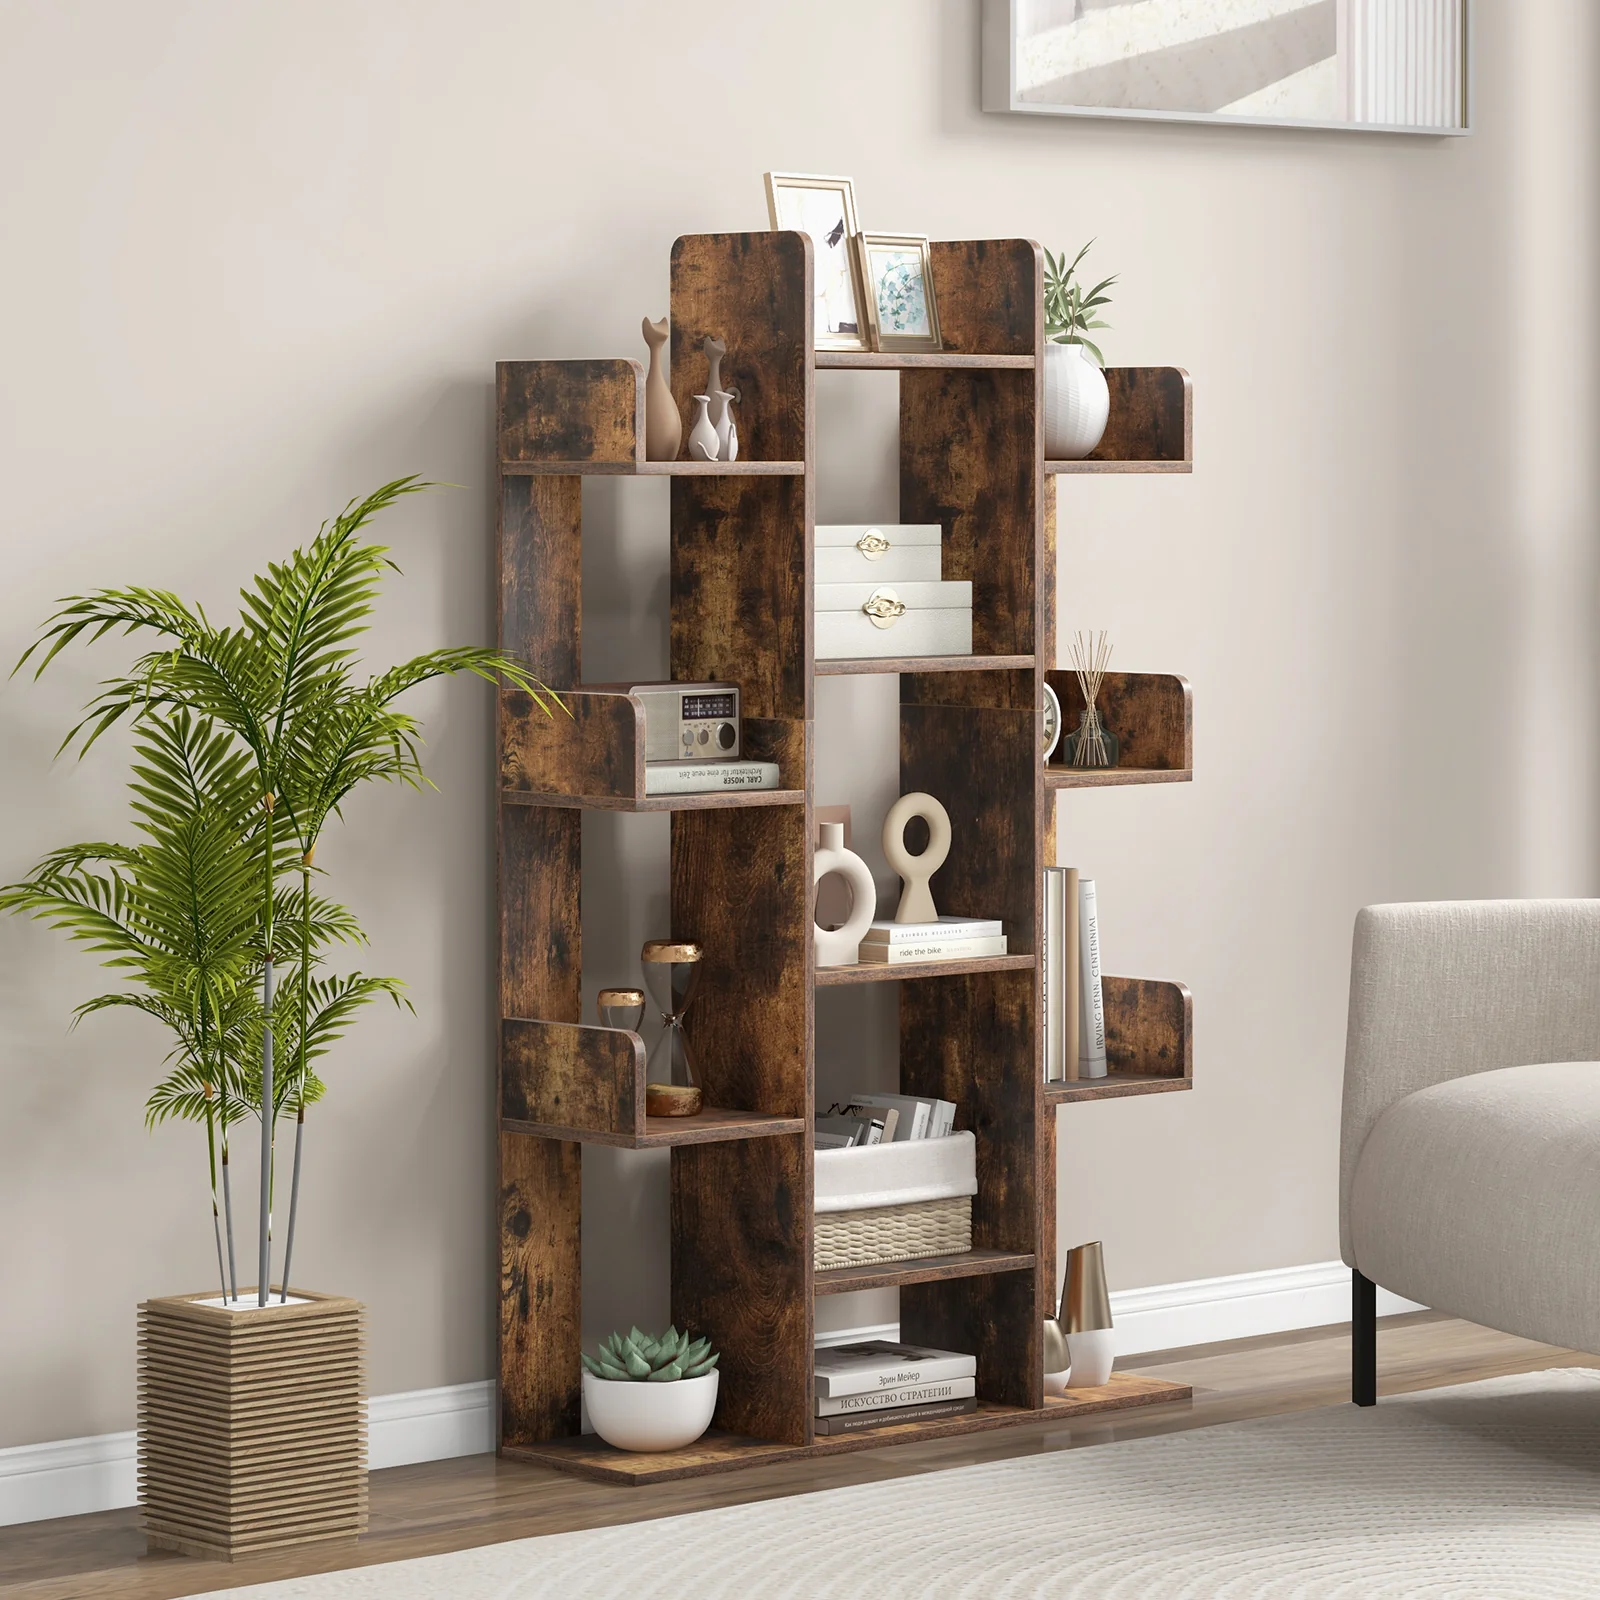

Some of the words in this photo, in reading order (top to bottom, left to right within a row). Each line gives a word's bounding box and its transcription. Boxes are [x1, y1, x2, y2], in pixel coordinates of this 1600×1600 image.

[678, 771, 691, 779] Zeit
[730, 768, 763, 776] Architektur
[723, 777, 745, 785] MOSER
[747, 776, 762, 784] CARL
[1088, 915, 1099, 978] CENTENNIAL
[899, 948, 913, 957] ride
[914, 948, 926, 956] the
[927, 947, 942, 955] bike
[1094, 1012, 1104, 1050] IRVING
[878, 1375, 896, 1387] Эрин
[897, 1371, 920, 1384] Мейер
[840, 1393, 898, 1409] ИСКУССТВО
[899, 1386, 952, 1401] СТРАТЕГИИ
